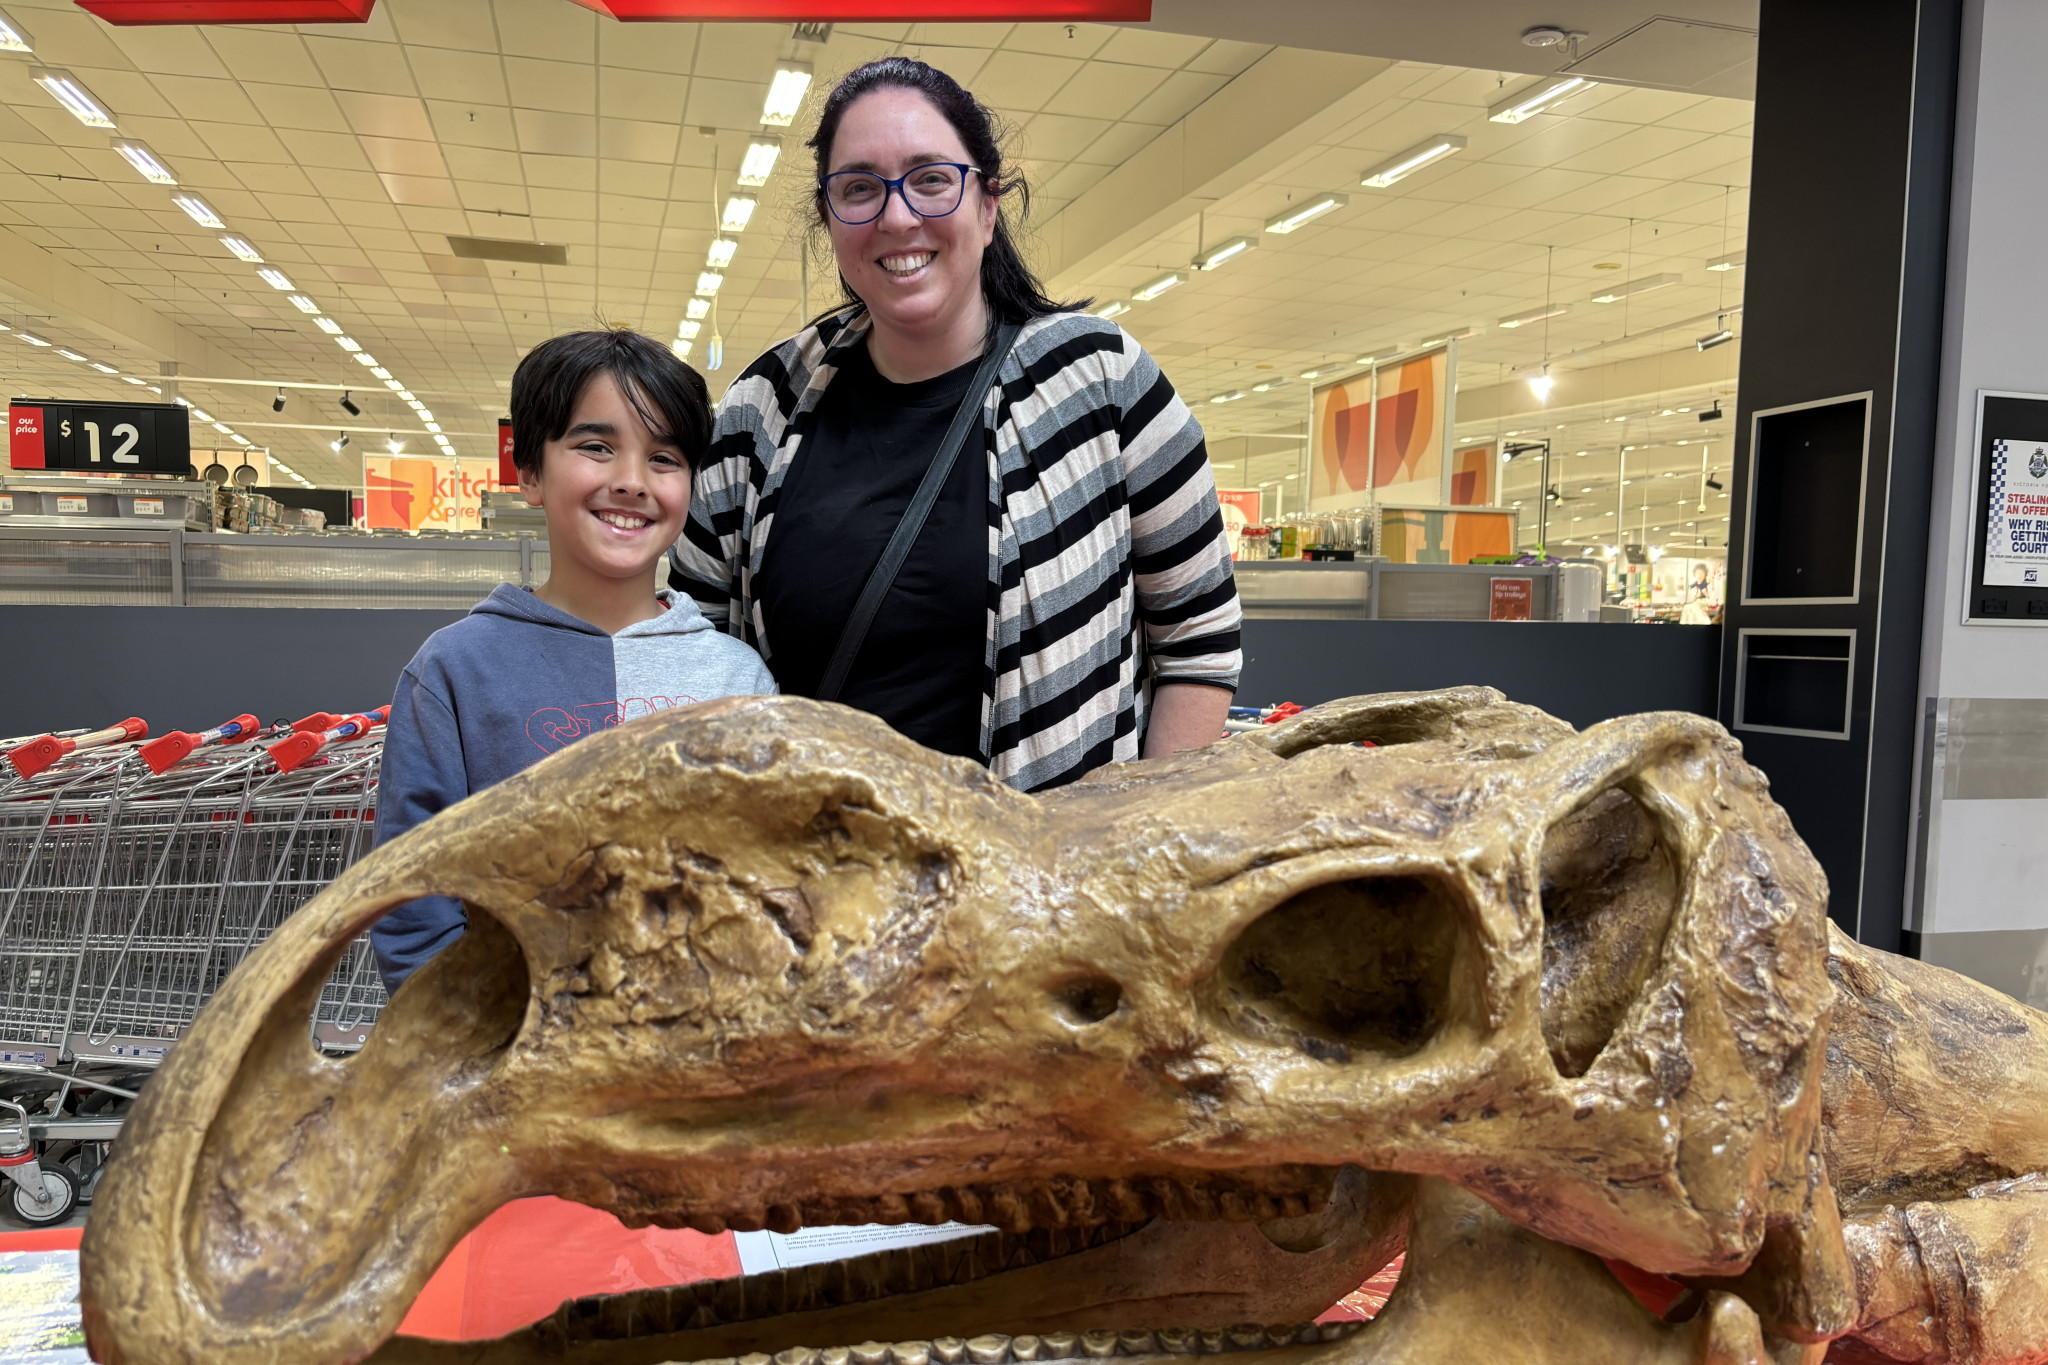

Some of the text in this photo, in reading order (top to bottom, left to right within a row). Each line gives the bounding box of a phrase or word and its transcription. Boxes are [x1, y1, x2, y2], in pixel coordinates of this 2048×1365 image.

[15, 425, 38, 435] price
[60, 419, 140, 464] $ 12
[2007, 493, 2048, 505] STEALIN
[2005, 504, 2019, 515] AN
[2008, 518, 2033, 530] WHY
[2011, 541, 2048, 554] COURT
[1504, 592, 1526, 600] trolleys
